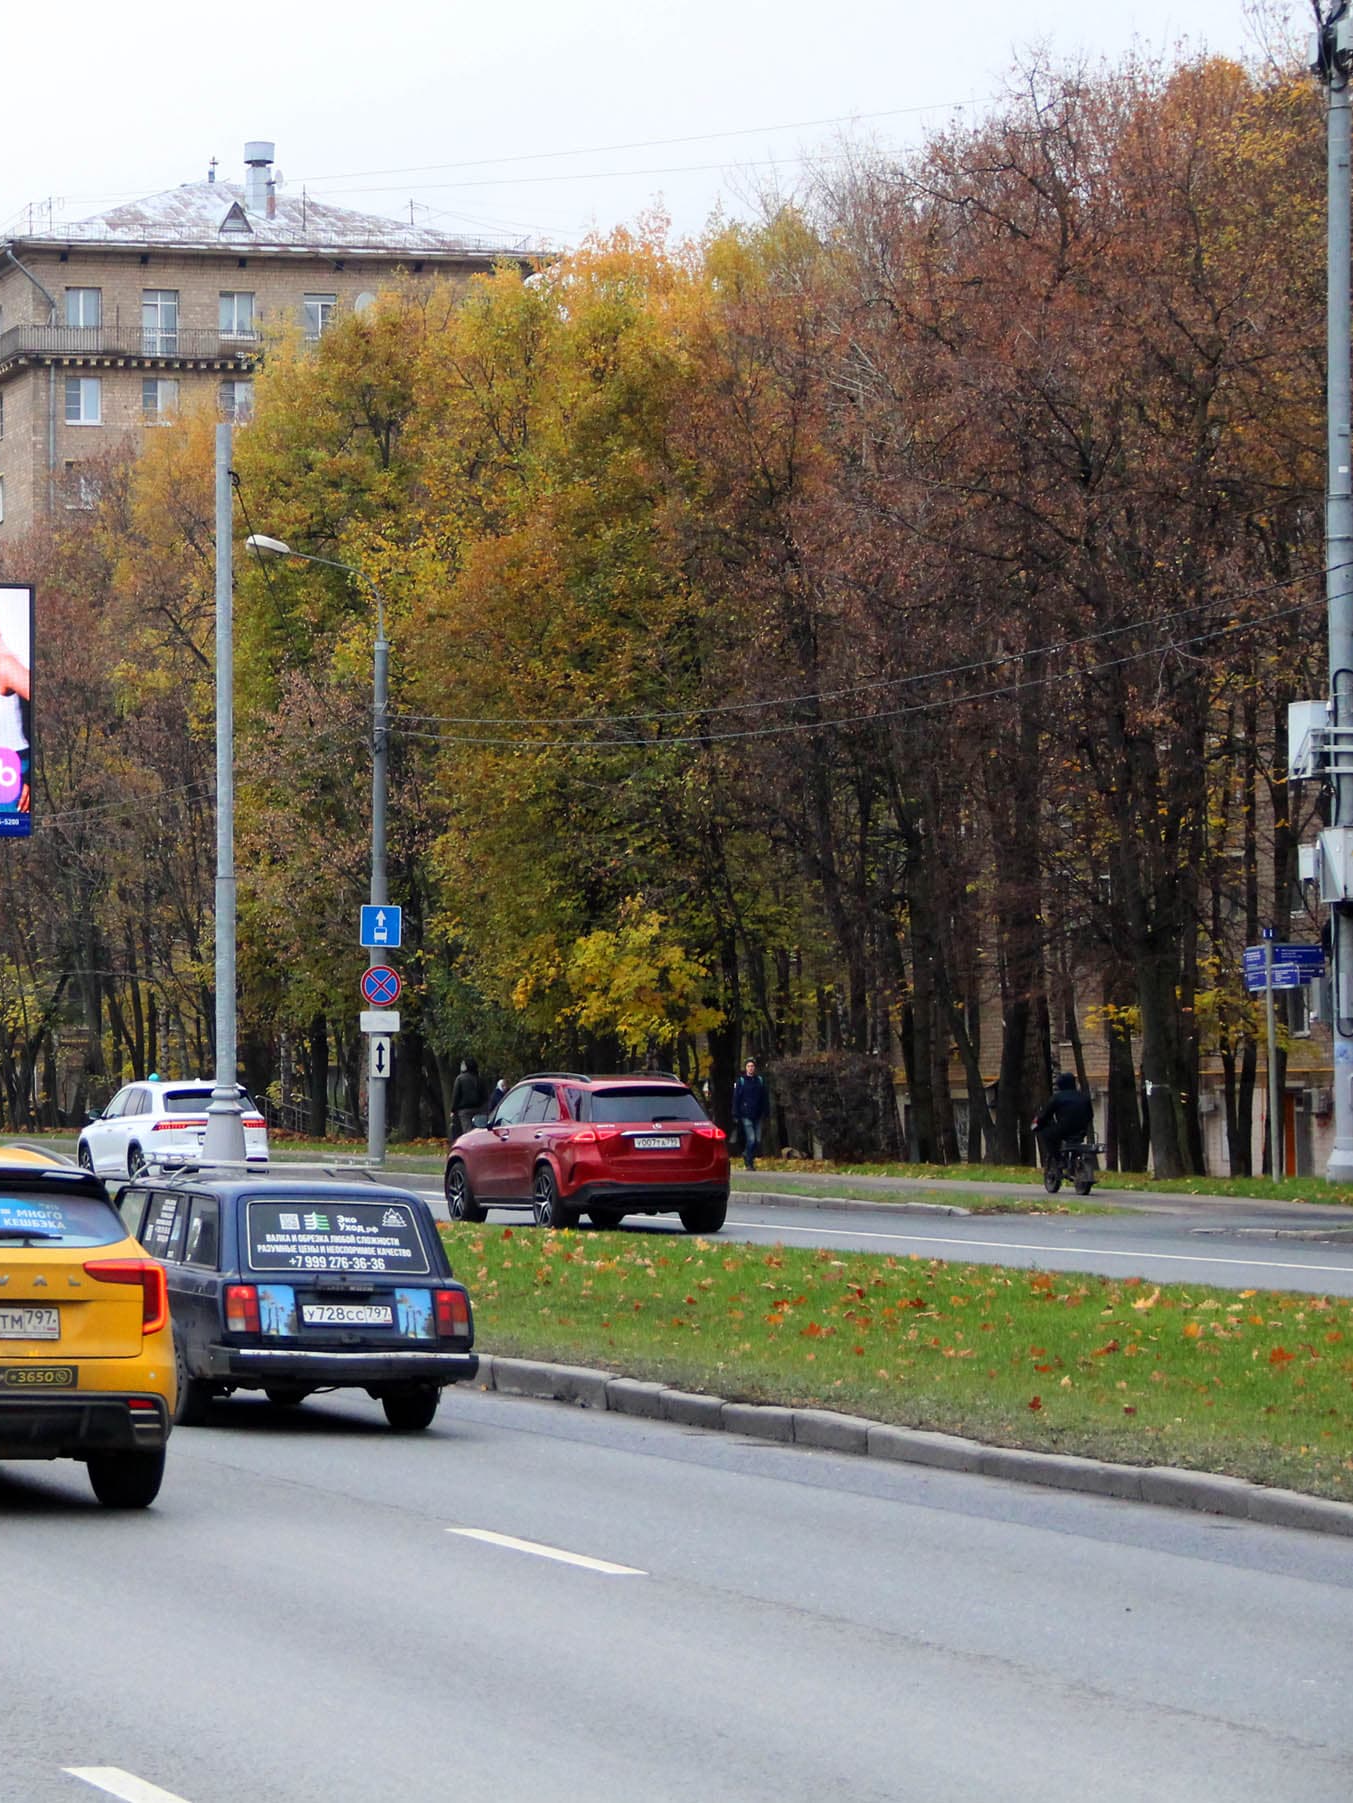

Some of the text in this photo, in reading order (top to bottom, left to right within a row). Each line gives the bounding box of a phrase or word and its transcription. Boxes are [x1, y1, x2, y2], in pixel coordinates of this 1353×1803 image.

[16, 1209, 63, 1220] МНОГО
[3, 1217, 67, 1230] КЕШБЭКА
[265, 1234, 291, 1243] ВАЛКА
[298, 1234, 329, 1243] ОБРЕЗКА
[330, 1233, 357, 1244] ЛЮБОЙ
[358, 1236, 400, 1246] СЛОЖНОСТИ
[377, 1247, 412, 1257] КАЧЕСТВО
[289, 1256, 385, 1269] +7 999 276-36-36
[25, 1309, 53, 1324] 797
[307, 1306, 388, 1321] У728СС 797
